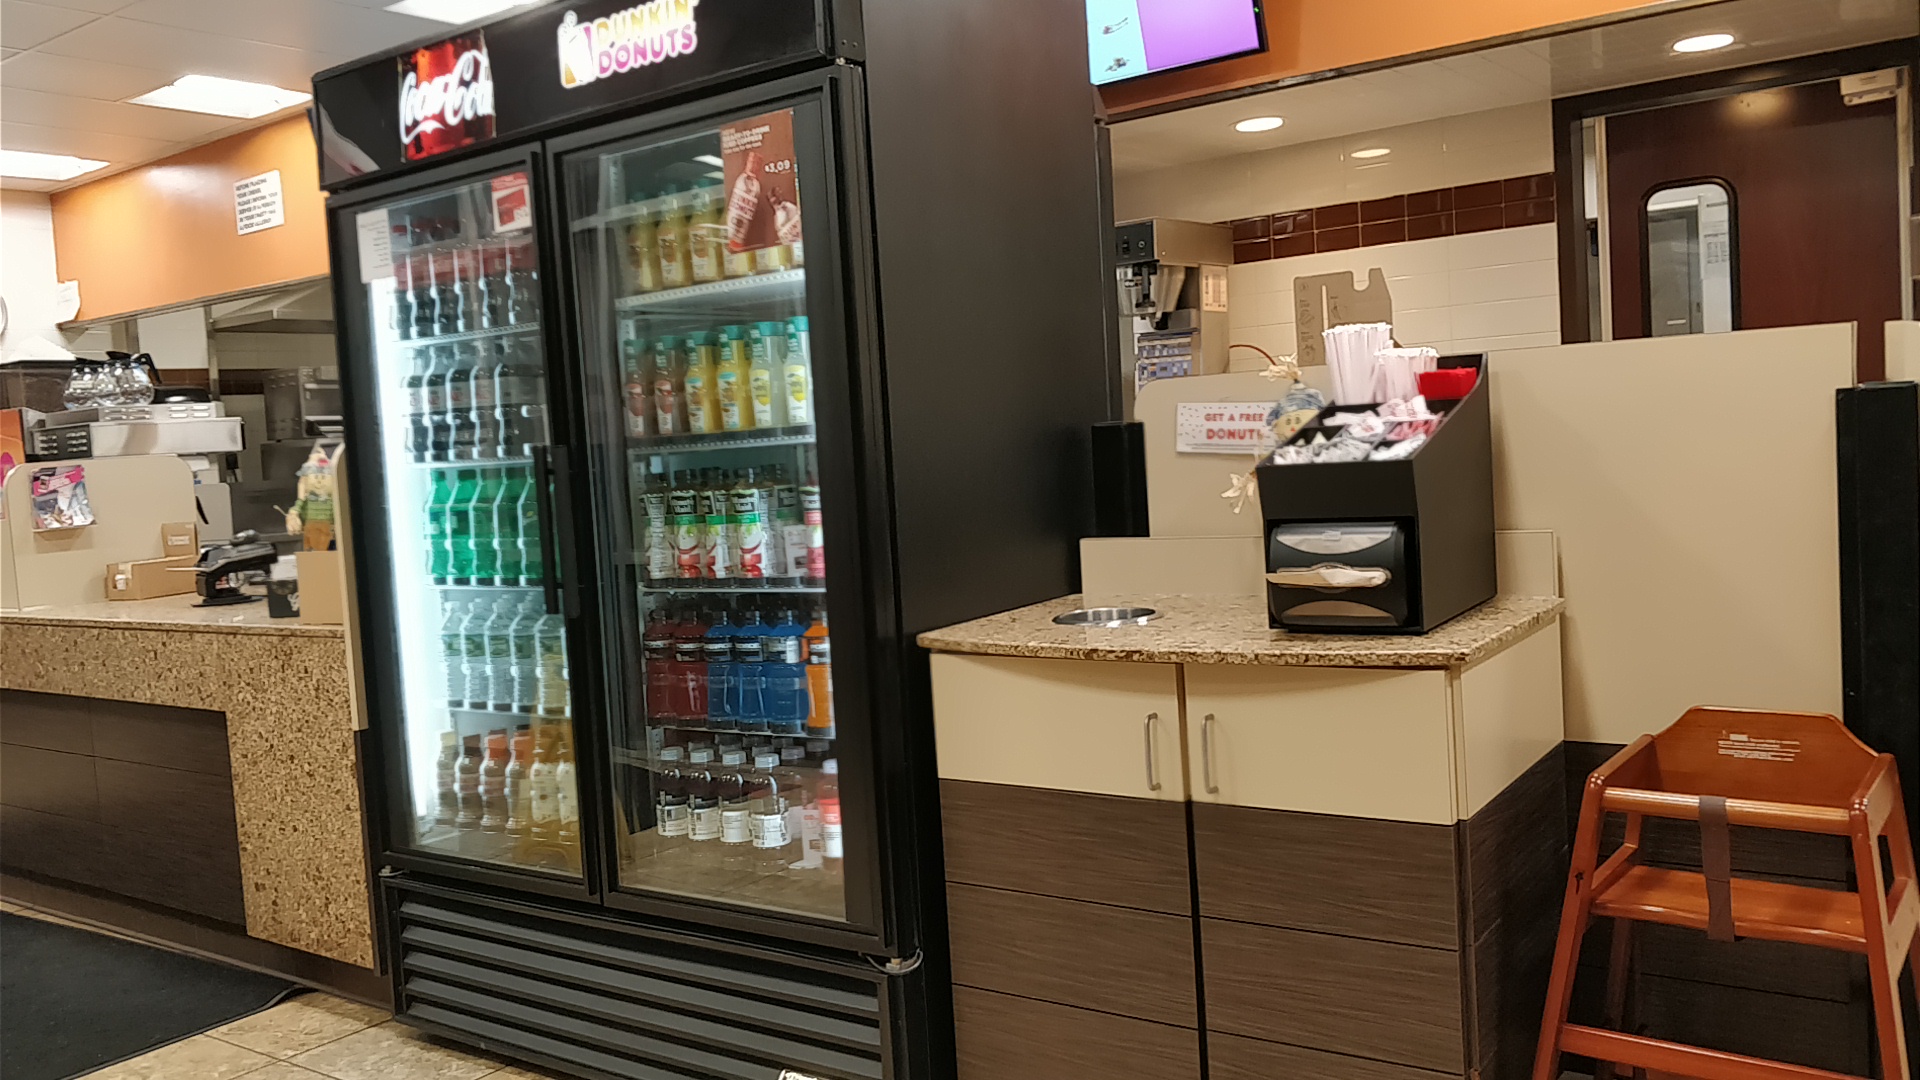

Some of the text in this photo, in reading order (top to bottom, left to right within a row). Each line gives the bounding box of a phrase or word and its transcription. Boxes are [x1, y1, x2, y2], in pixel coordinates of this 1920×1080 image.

[598, 24, 693, 75] DONUTS
[1204, 413, 1264, 422] GET A FREE
